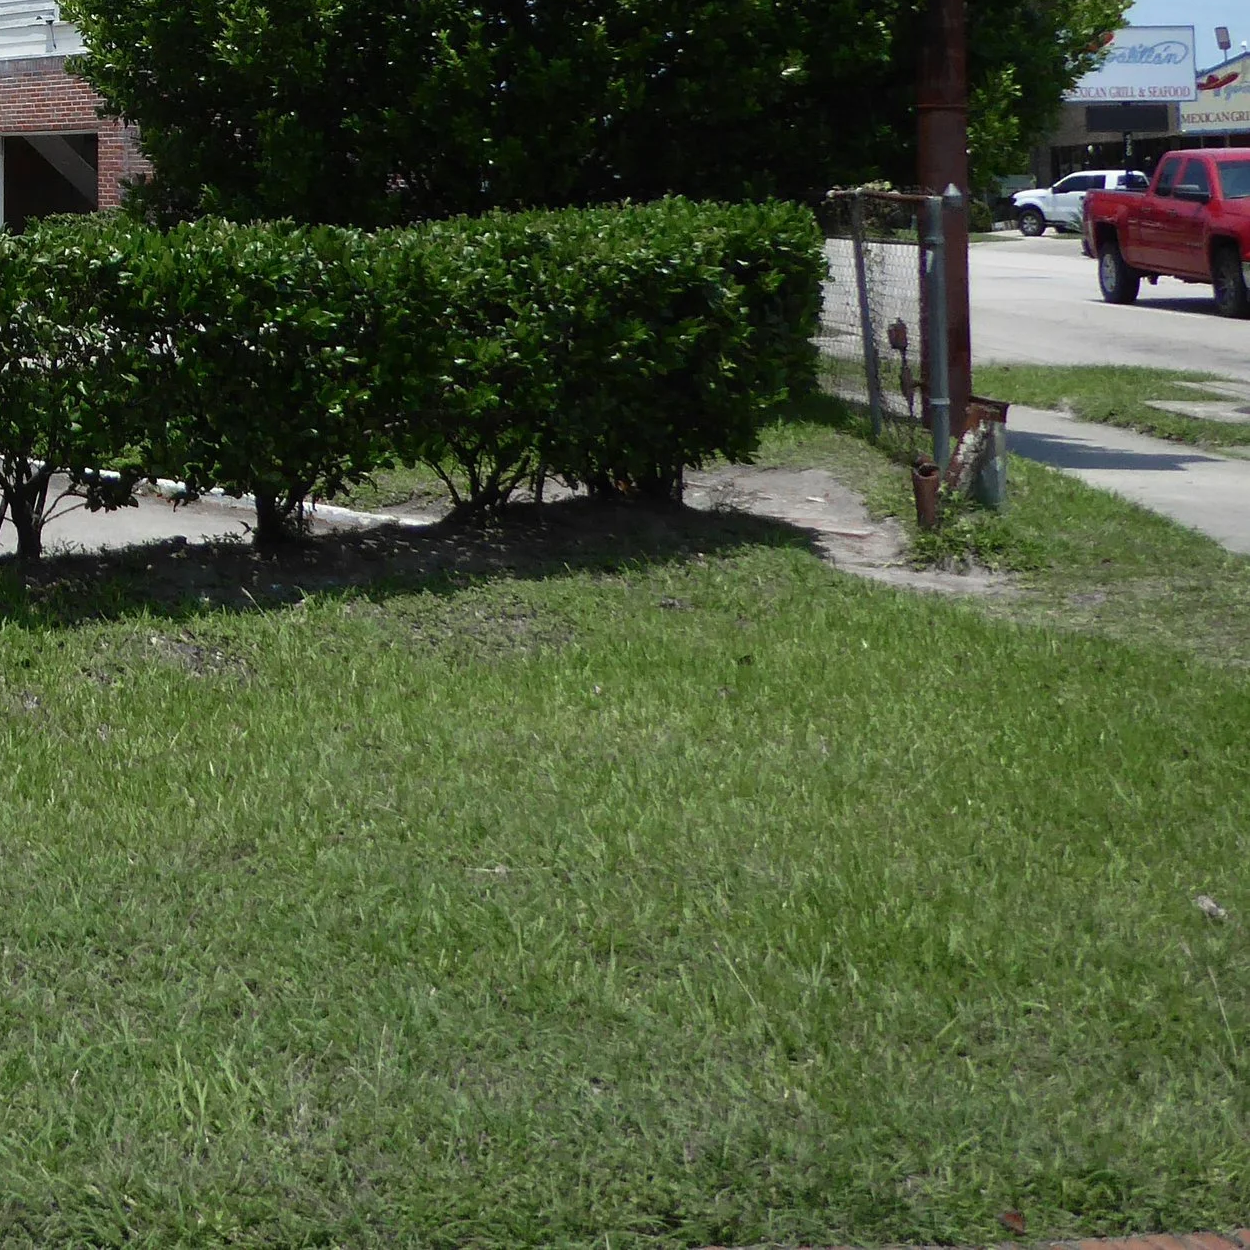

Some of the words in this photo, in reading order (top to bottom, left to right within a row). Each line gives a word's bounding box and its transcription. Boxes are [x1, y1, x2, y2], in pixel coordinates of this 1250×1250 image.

[1109, 86, 1134, 98] GRILL
[1138, 87, 1146, 97] &
[1149, 86, 1190, 98] SEAFOOD
